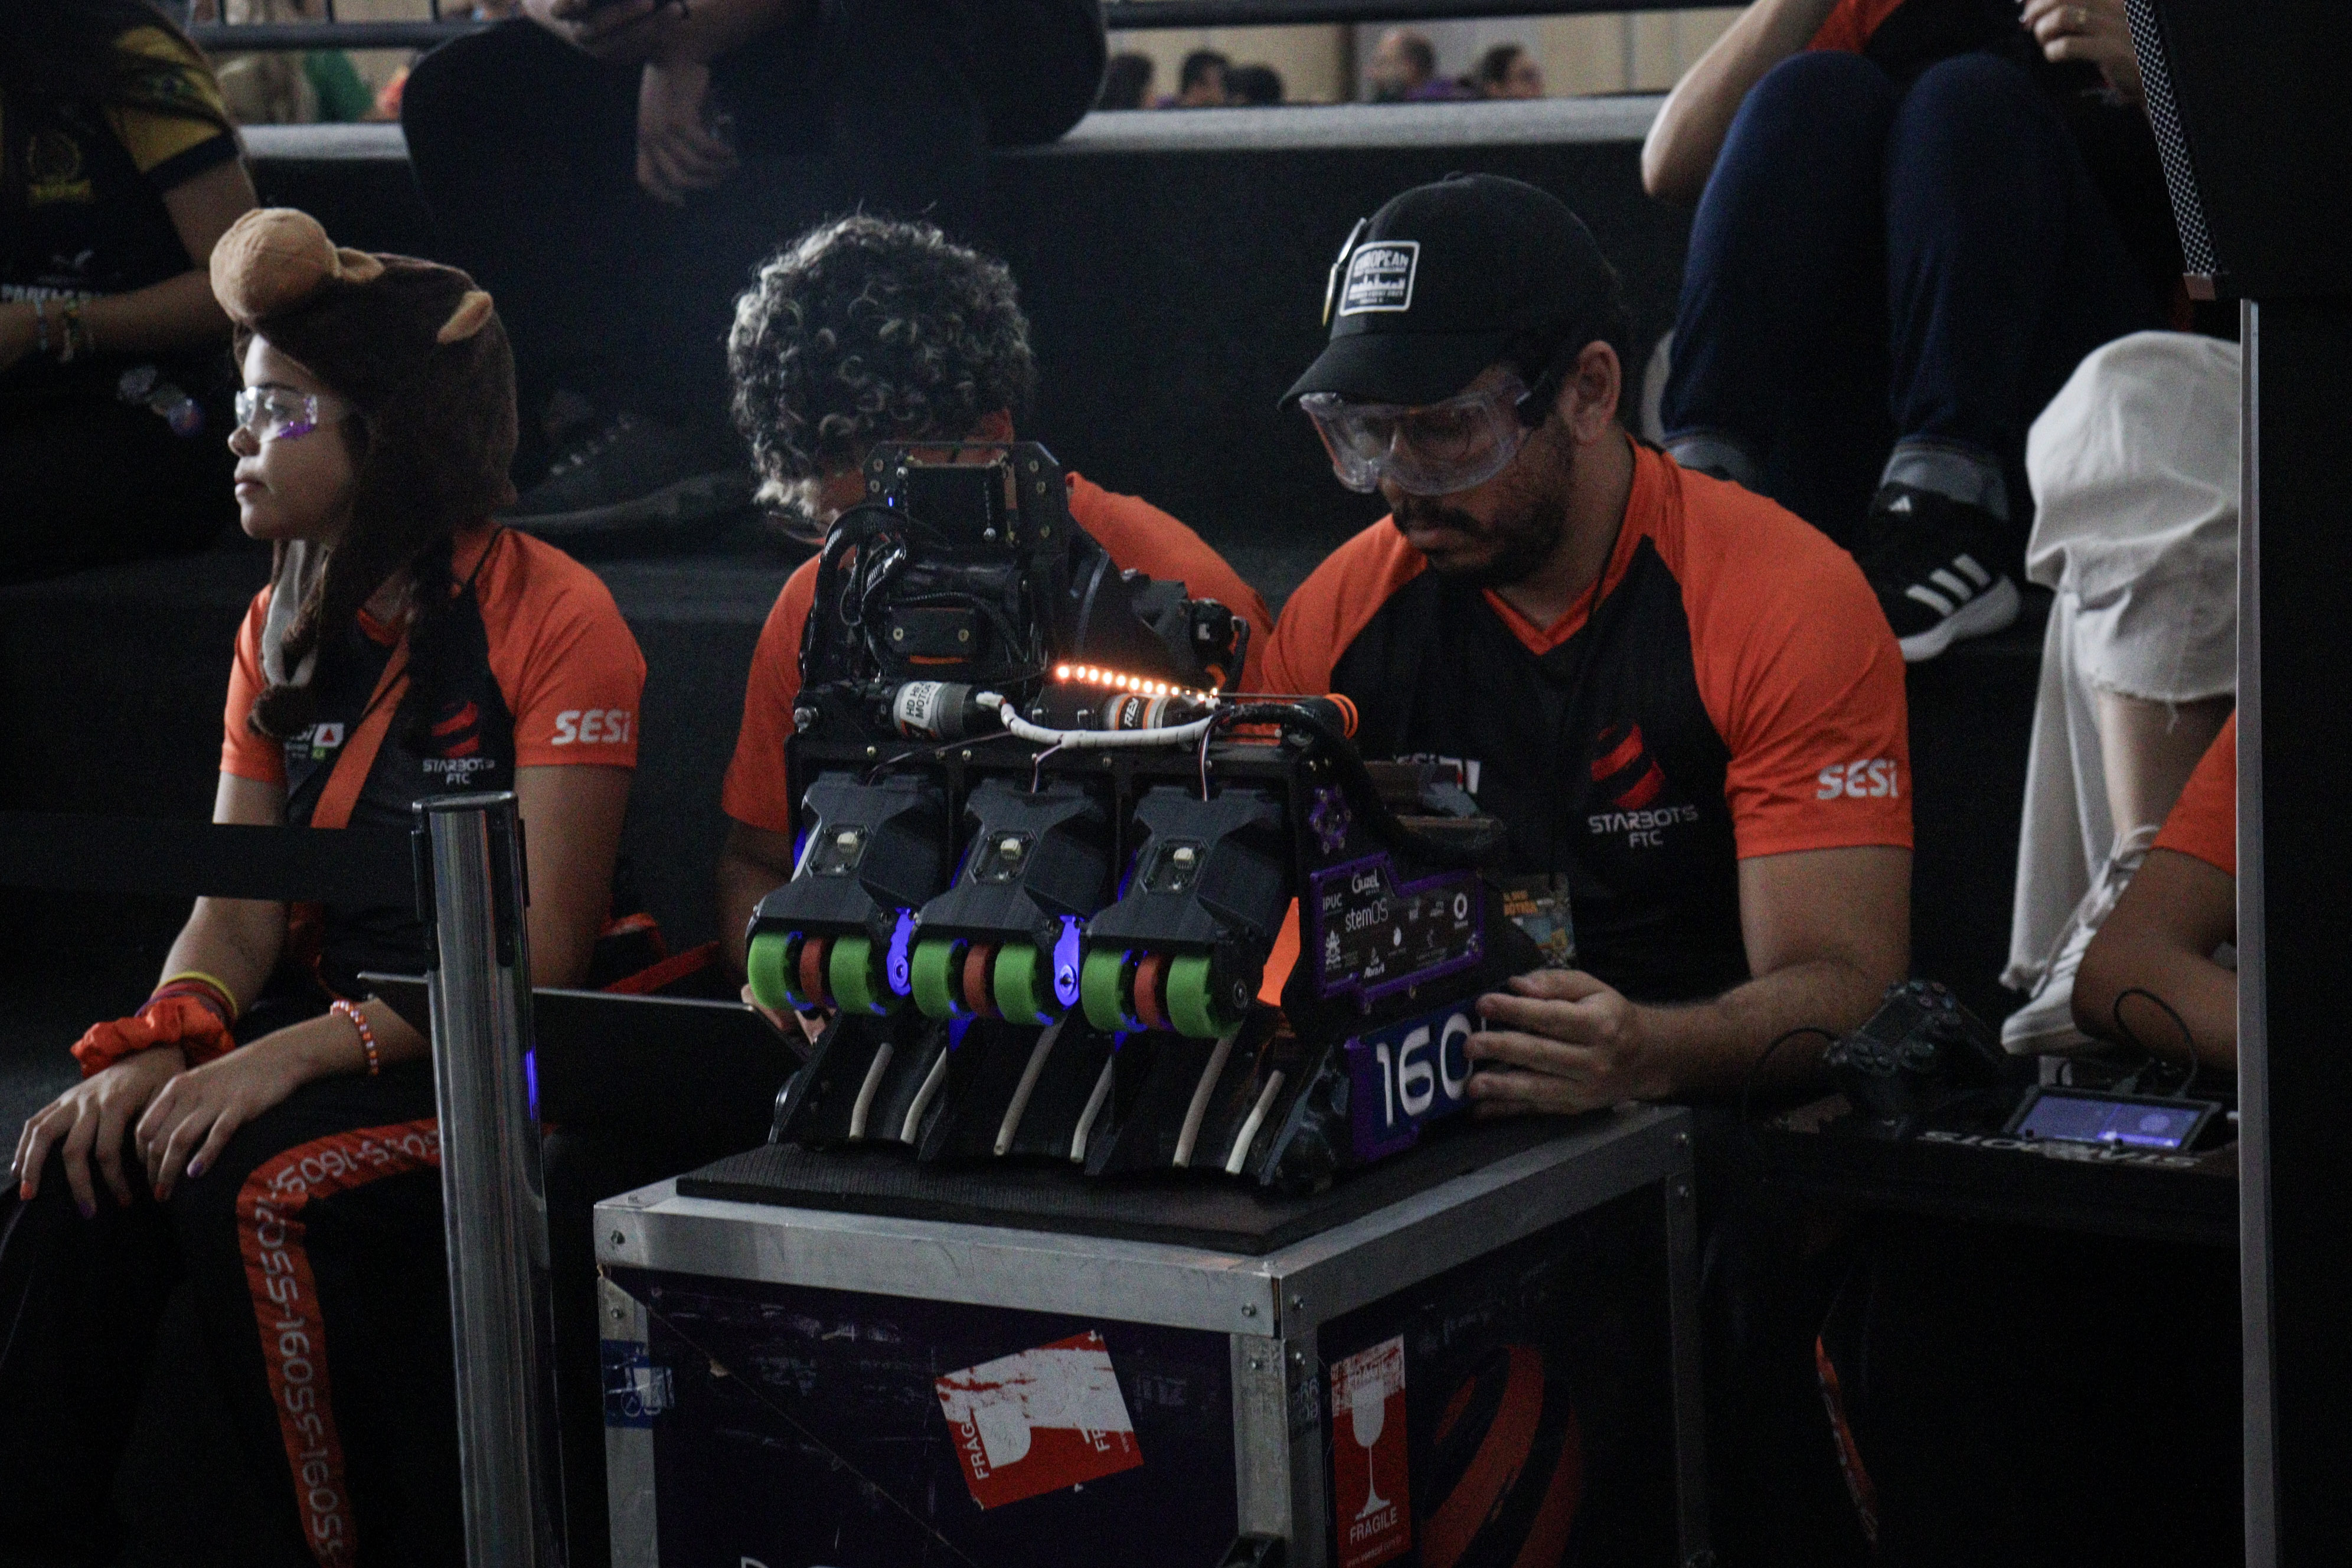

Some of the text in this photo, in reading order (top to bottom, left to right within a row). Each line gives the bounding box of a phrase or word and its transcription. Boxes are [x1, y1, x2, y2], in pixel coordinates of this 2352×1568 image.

[446, 773, 471, 785] FTC
[1587, 803, 1699, 834] STARBOTS
[1629, 829, 1664, 849] FTC
[1345, 897, 1389, 933] stemOS
[1376, 1012, 1487, 1128] 160
[1350, 1505, 1399, 1547] FRAGILE
